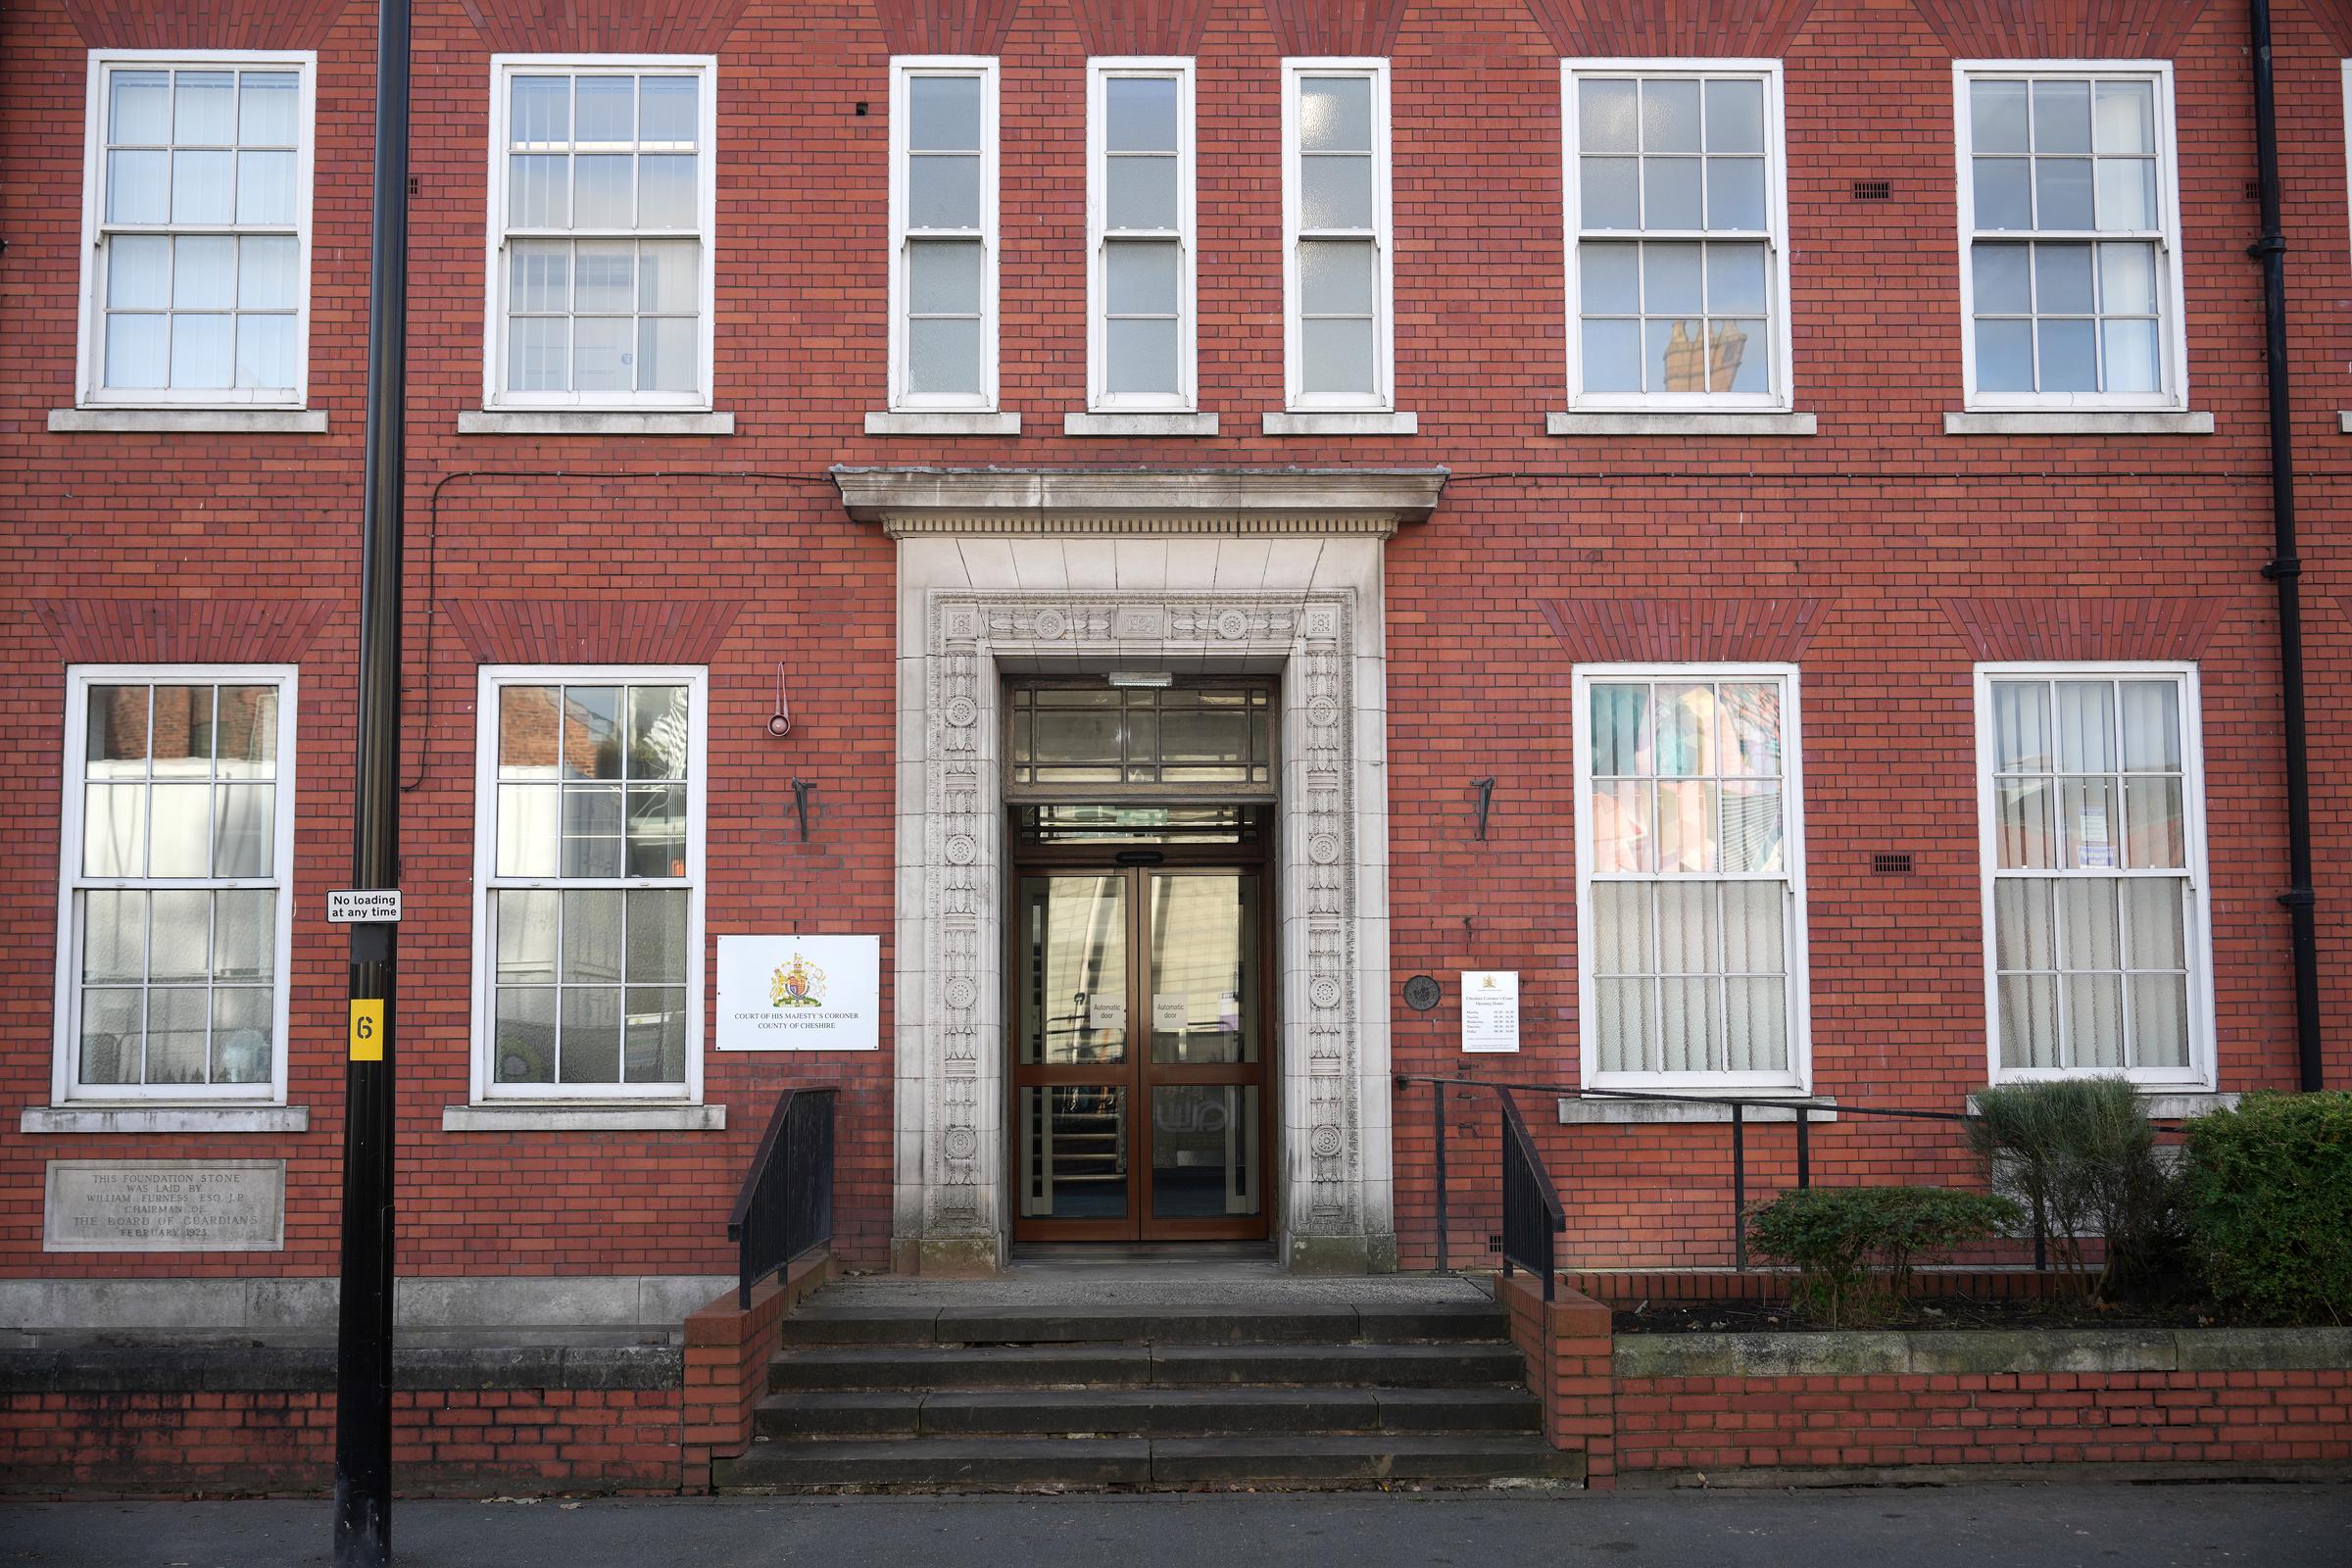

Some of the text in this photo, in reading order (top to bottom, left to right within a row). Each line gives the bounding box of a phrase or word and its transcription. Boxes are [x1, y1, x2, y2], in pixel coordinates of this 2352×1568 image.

[333, 895, 396, 906] No loading
[332, 906, 397, 918] at any time
[357, 1015, 372, 1039] 6
[92, 1173, 240, 1183] THIS FOUNDATION STONE
[126, 1184, 203, 1193] WAS LAID BY
[86, 1194, 131, 1202] WILLIAM
[141, 1194, 189, 1202] FURNESS
[123, 1204, 206, 1214] CHAIRMAN OF
[73, 1215, 259, 1226] THE BOARD OF GUARDIANS
[120, 1227, 179, 1238] FEBRUARY
